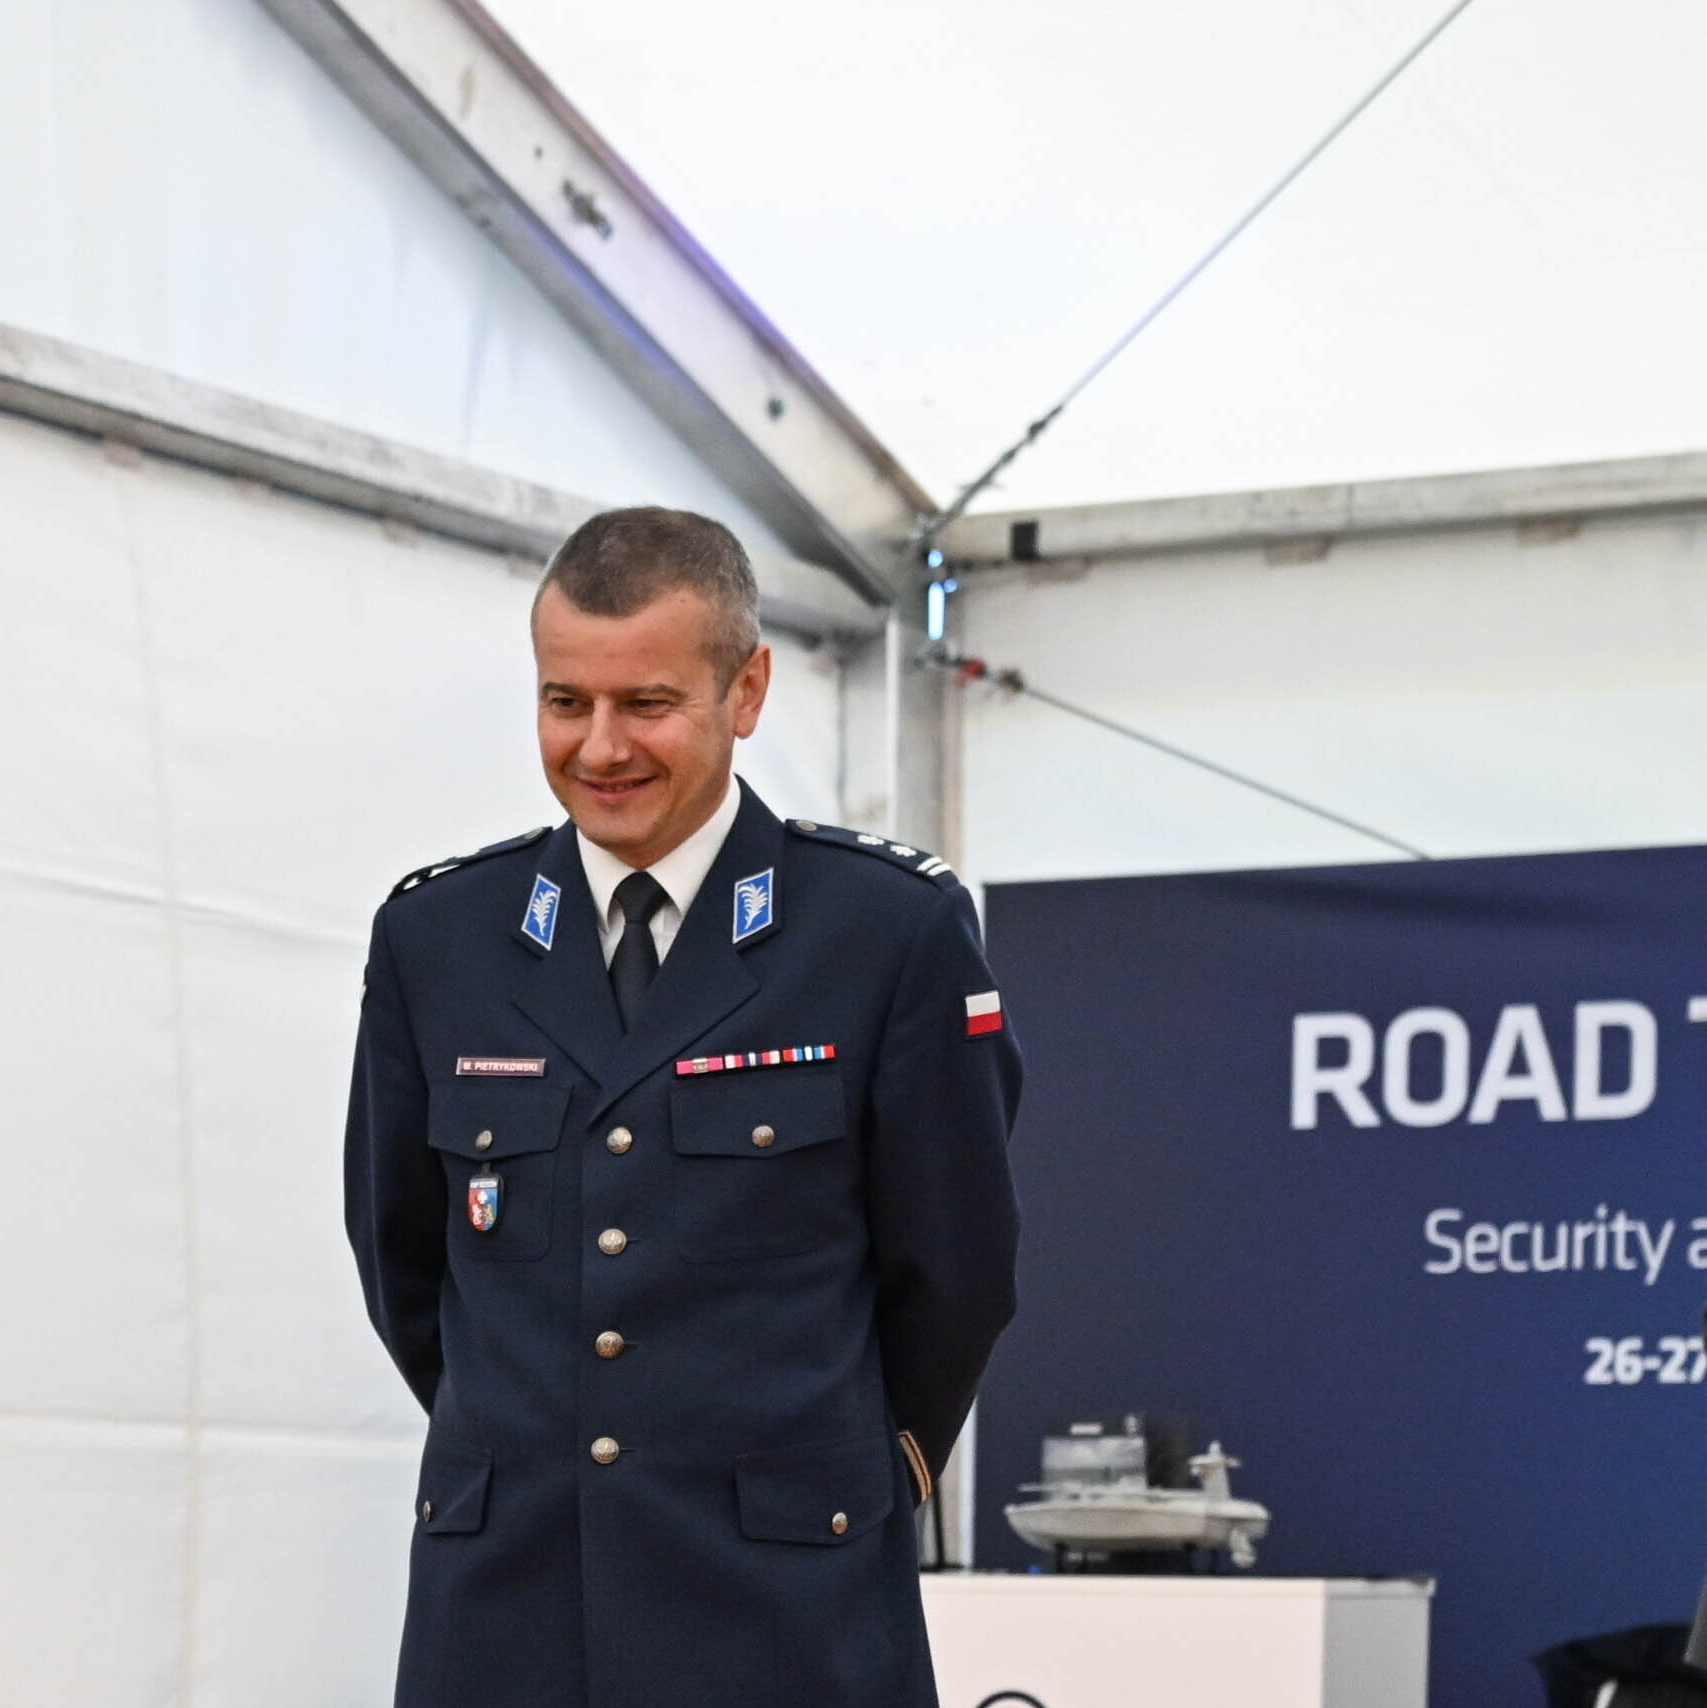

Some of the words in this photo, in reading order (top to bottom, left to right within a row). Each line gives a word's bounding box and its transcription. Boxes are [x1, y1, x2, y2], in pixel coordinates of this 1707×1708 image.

[1291, 999, 1658, 1130] ROAD
[1424, 1203, 1675, 1286] Security
[1584, 1338, 1706, 1386] 26-27
